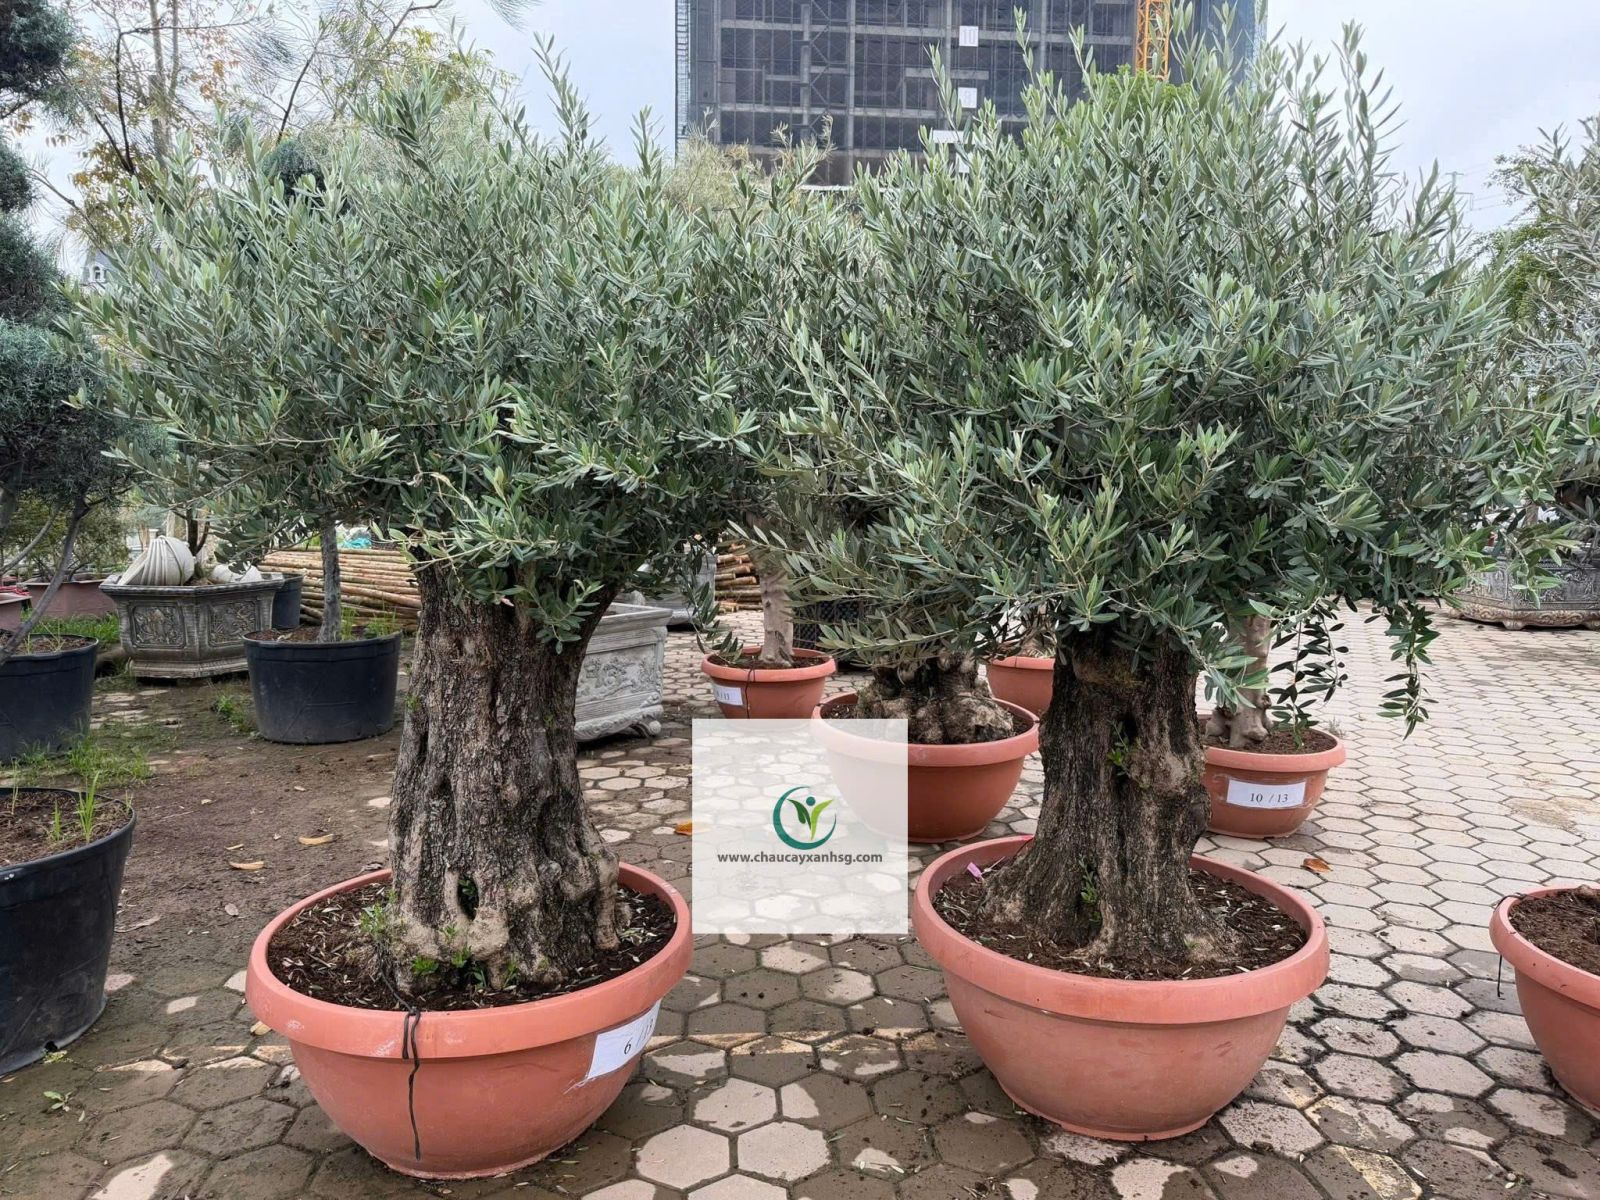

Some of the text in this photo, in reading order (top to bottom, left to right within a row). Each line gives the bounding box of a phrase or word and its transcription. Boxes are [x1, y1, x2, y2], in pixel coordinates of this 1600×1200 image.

[1250, 792, 1263, 803] 10
[1277, 793, 1289, 803] 13
[624, 1036, 632, 1055] 6
